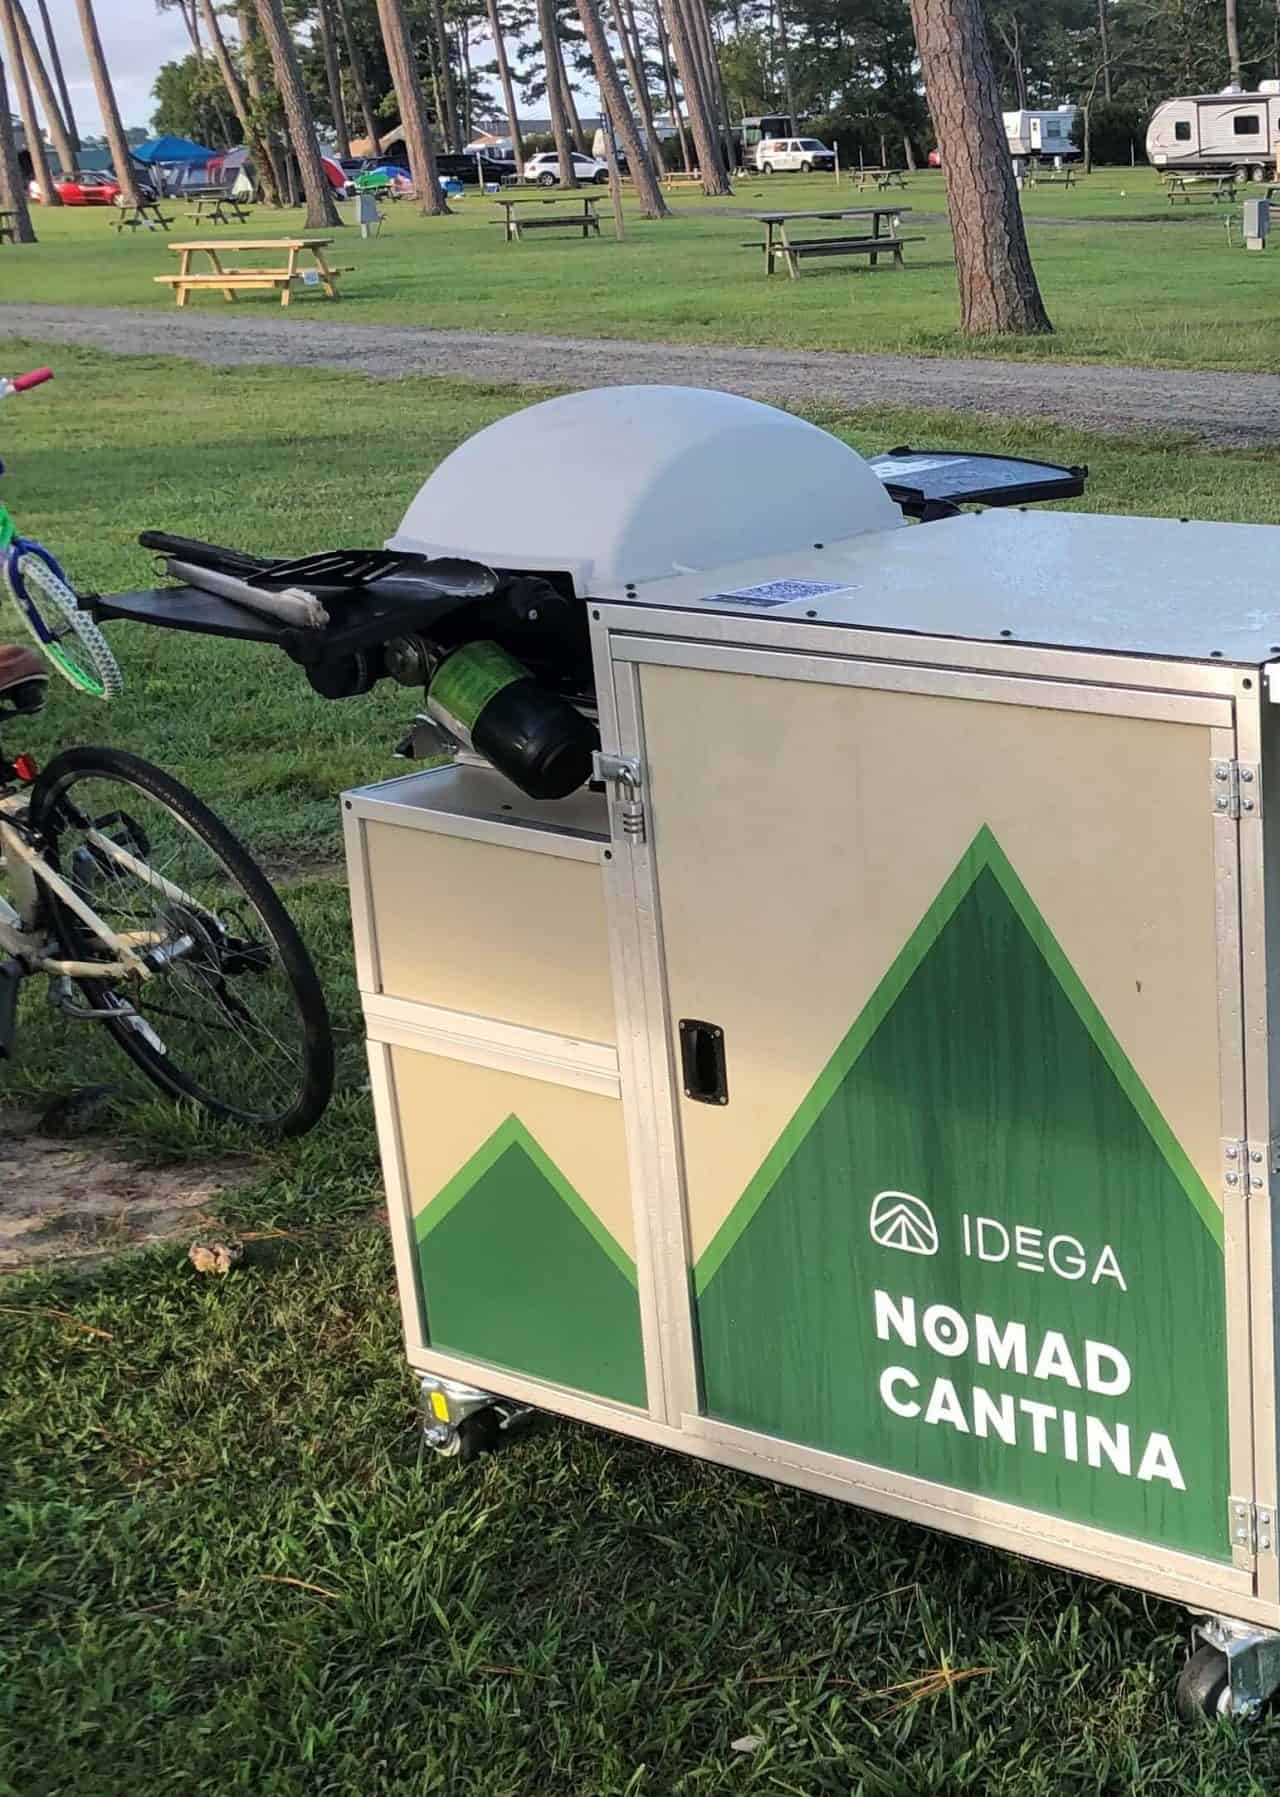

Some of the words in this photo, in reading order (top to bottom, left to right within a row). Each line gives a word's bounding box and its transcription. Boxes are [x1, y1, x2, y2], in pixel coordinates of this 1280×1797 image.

[962, 1213, 1128, 1292] IDEGA
[874, 1289, 1132, 1397] NOMAD
[879, 1366, 1187, 1491] CANTINA
